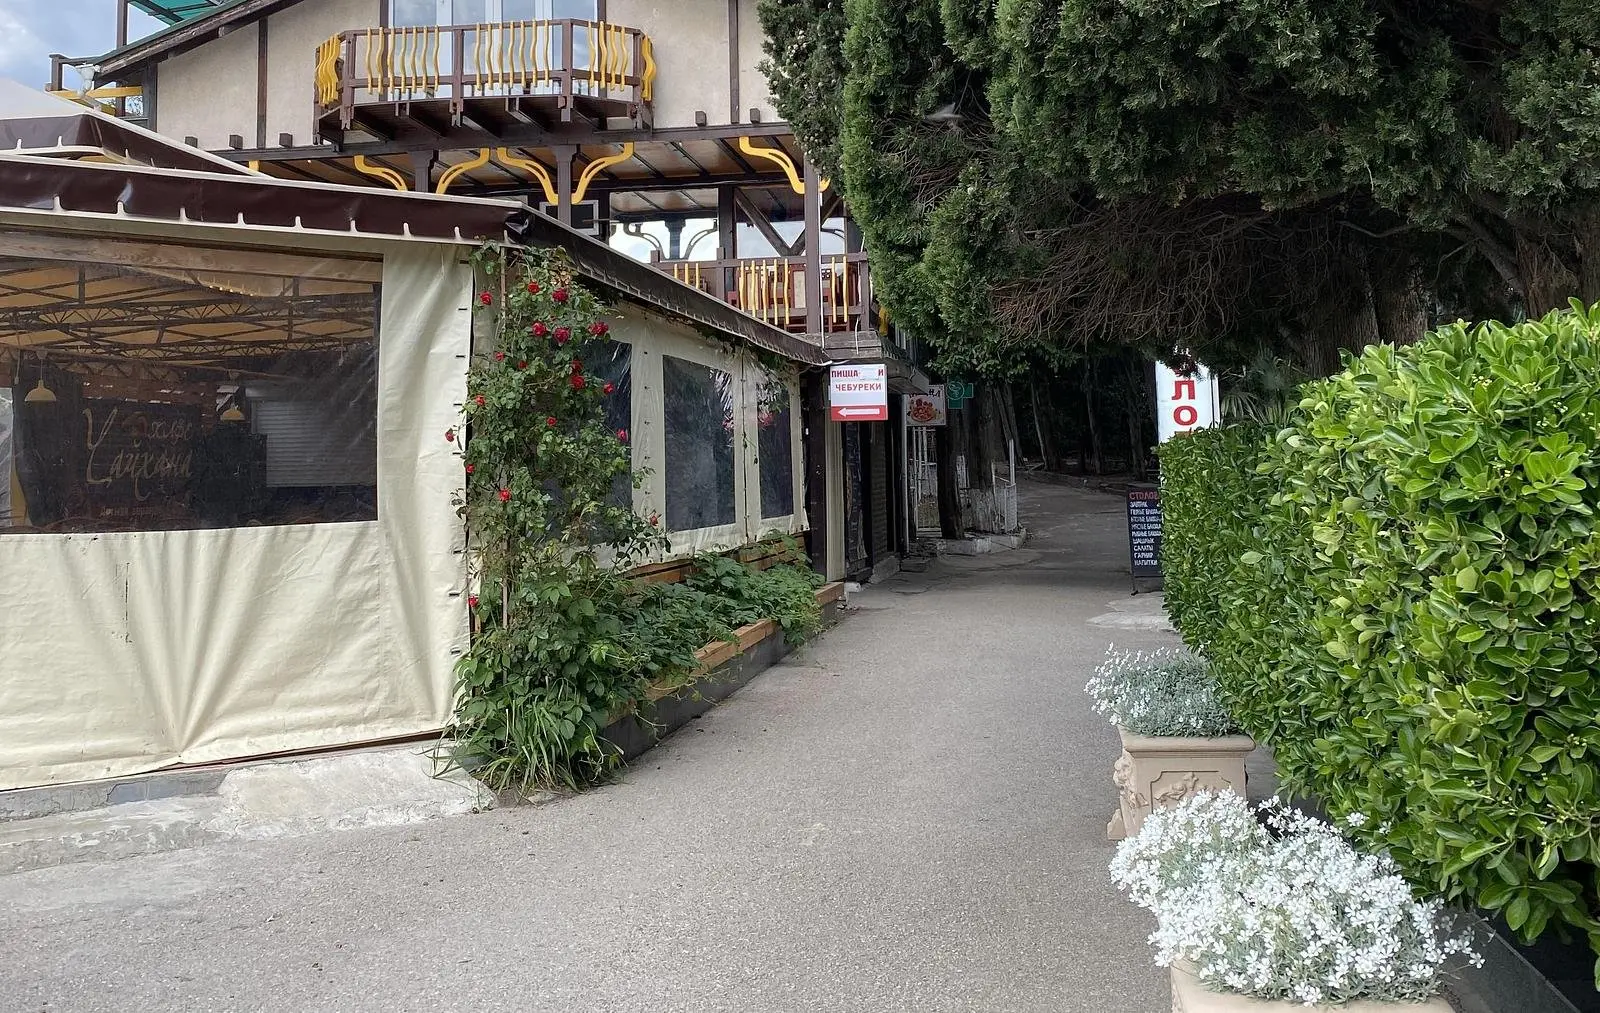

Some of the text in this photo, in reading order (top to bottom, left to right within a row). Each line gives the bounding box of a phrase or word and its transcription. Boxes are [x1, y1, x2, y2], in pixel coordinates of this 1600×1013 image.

[832, 369, 884, 378] ПИЦЦА И
[836, 383, 881, 391] ЧЕБУРЕКИ
[1171, 370, 1198, 434] ЛО
[1129, 491, 1158, 500] СТОЛОВ
